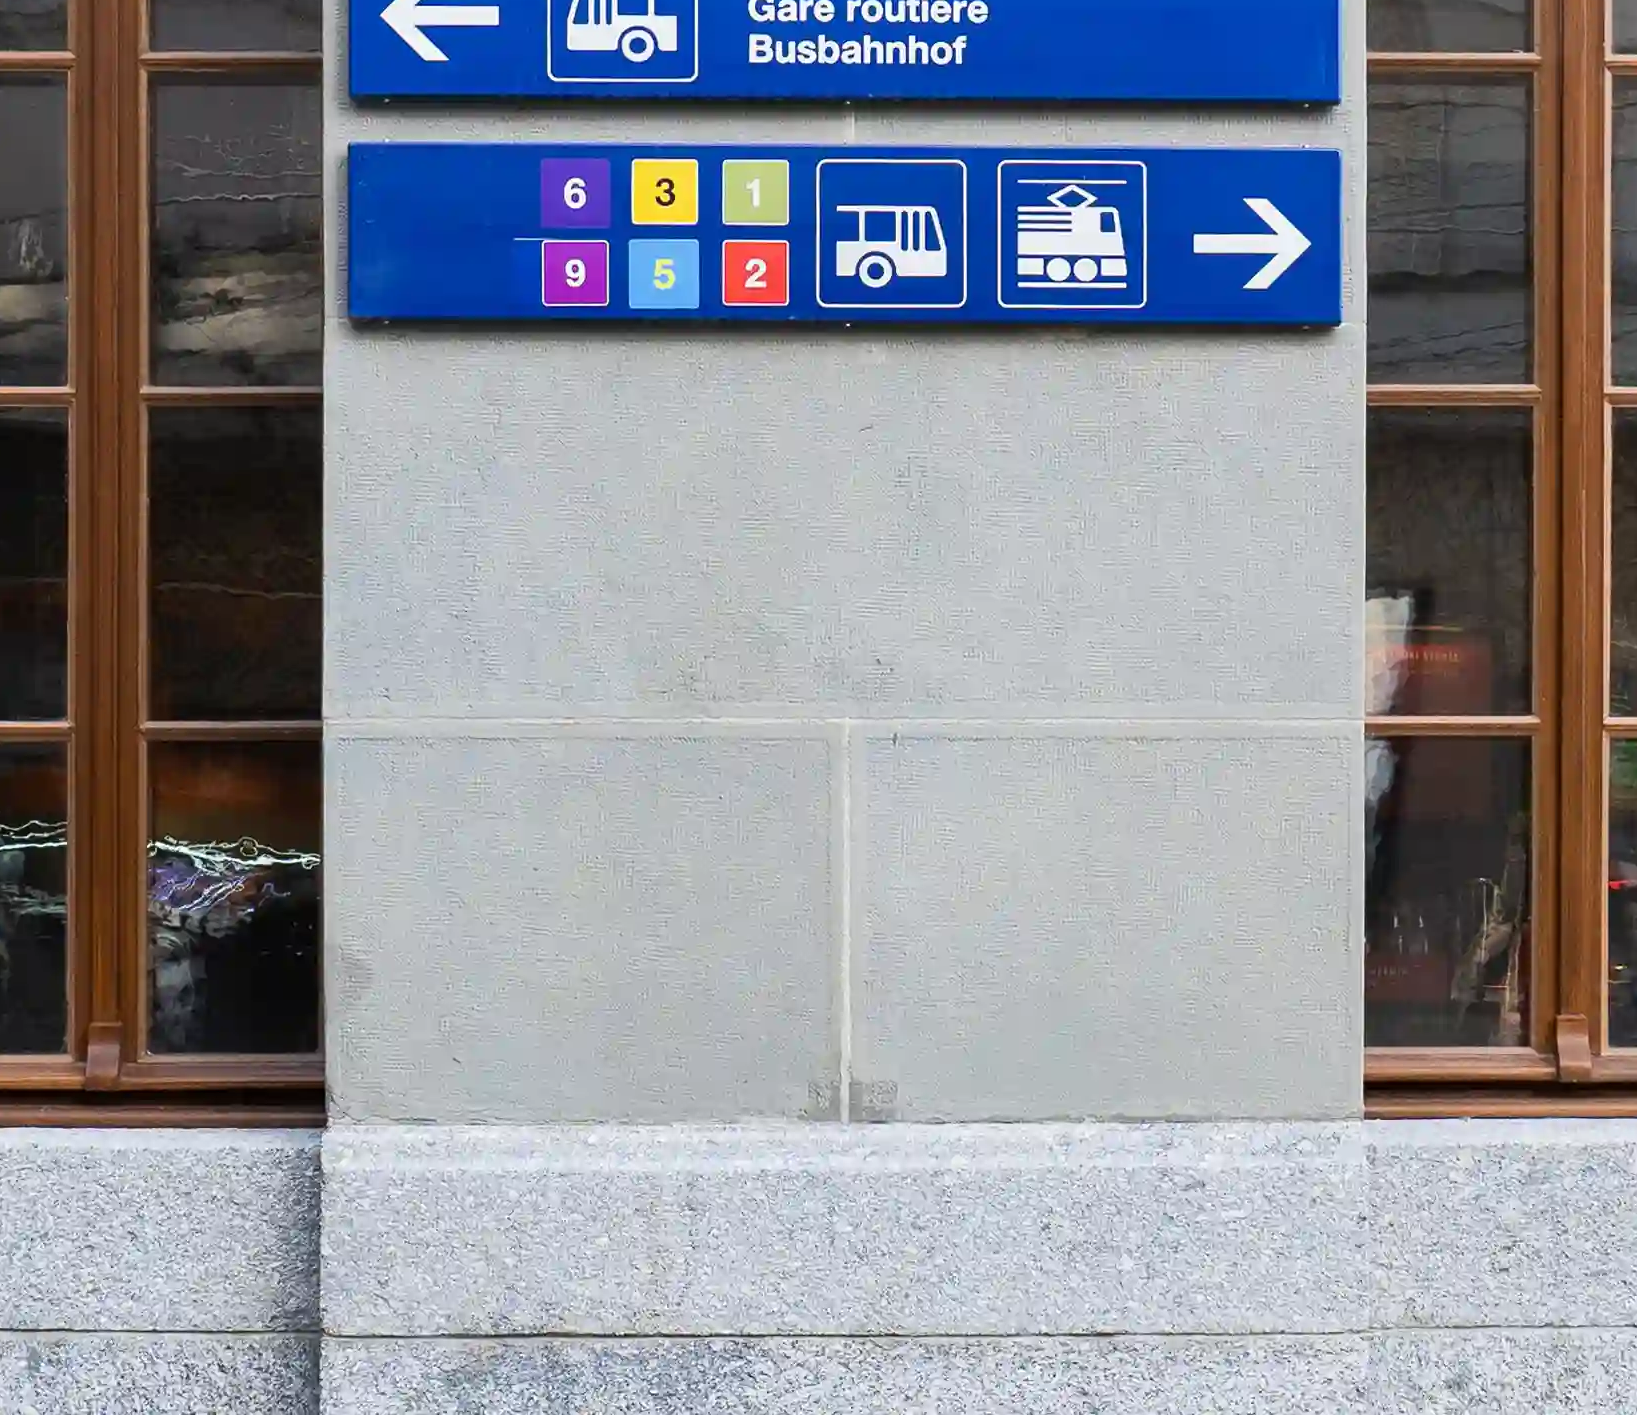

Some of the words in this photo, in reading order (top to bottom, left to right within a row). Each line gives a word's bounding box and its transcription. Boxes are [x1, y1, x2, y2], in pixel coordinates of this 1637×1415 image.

[748, 34, 967, 65] Busbahnhof
[563, 177, 588, 209] 6
[655, 178, 676, 207] 3
[745, 178, 761, 208] 1
[565, 259, 587, 288] 9
[653, 258, 676, 290] 5
[744, 258, 767, 288] 2
